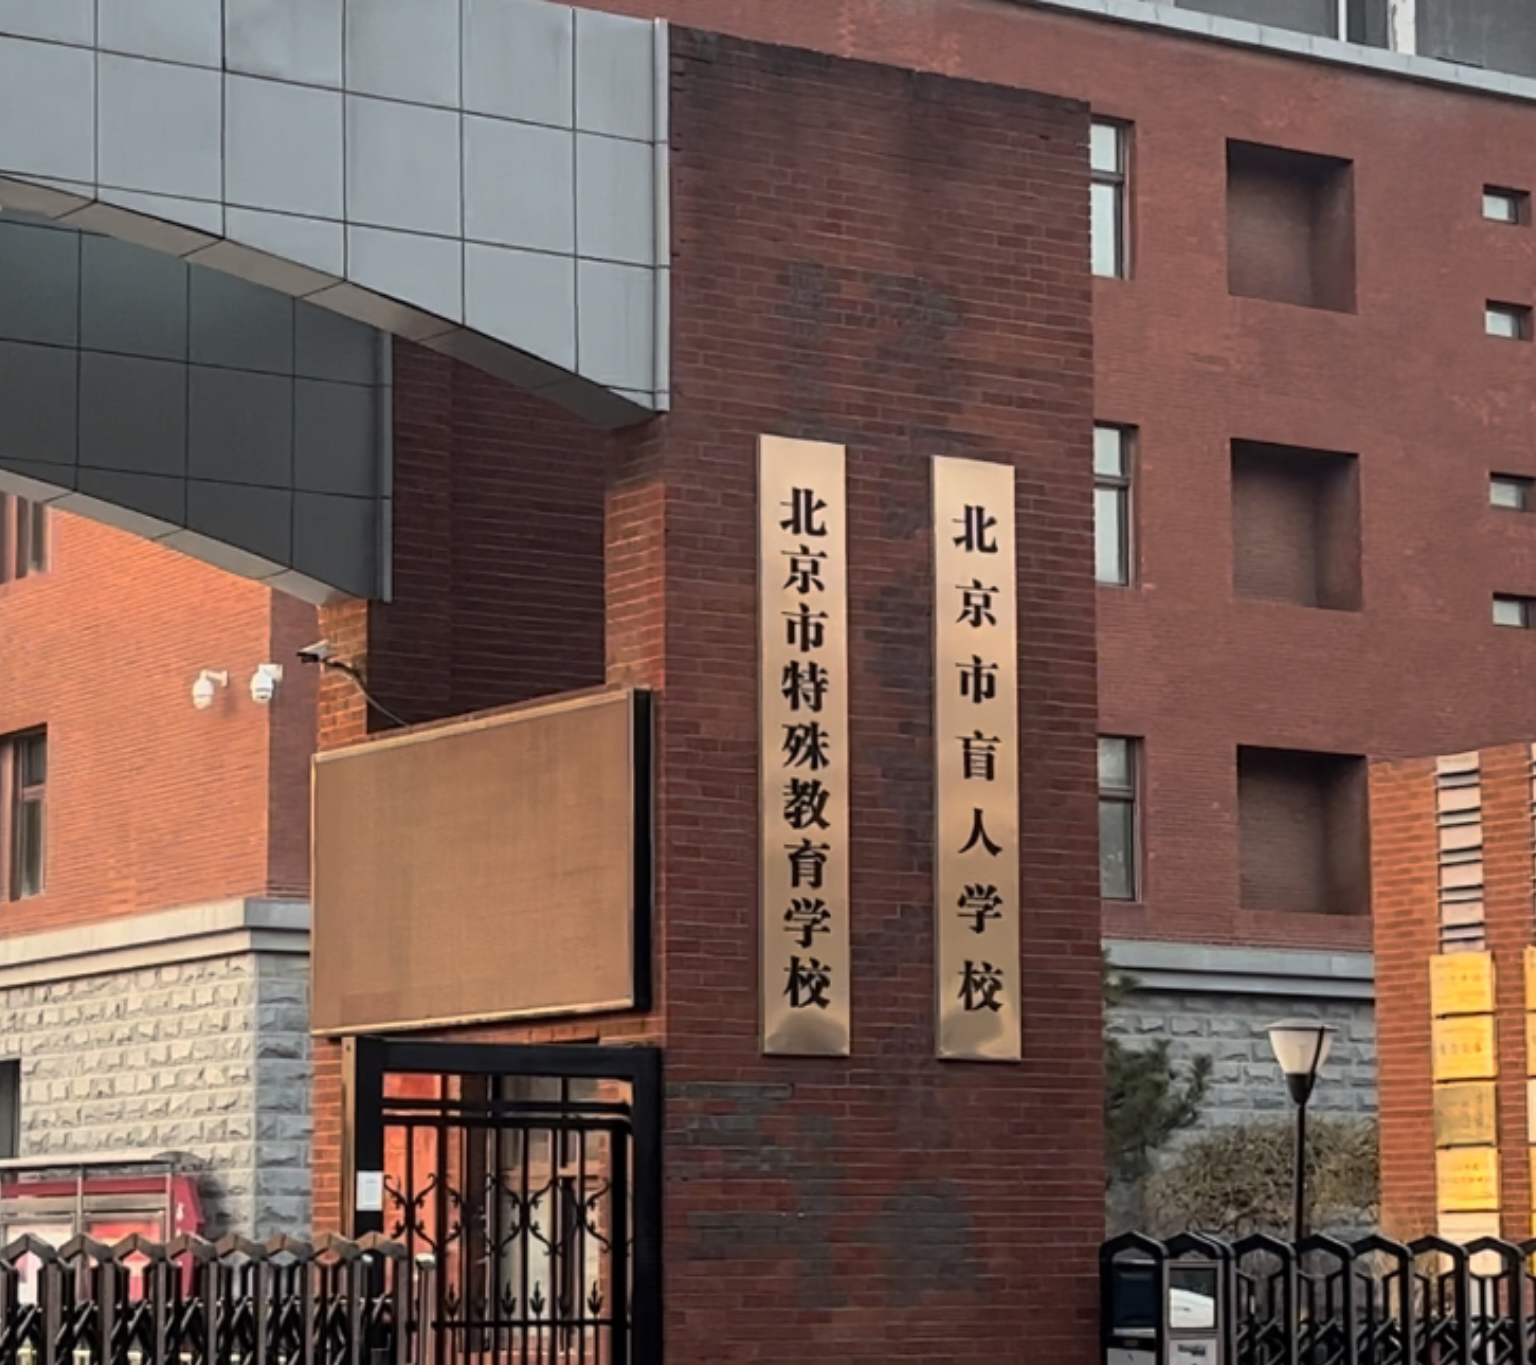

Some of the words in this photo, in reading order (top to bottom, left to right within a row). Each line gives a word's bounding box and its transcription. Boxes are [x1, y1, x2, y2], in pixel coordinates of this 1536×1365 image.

[780, 486, 831, 1010] 北京市特殊教育学校
[952, 505, 1004, 1013] 北京市盲人学校
